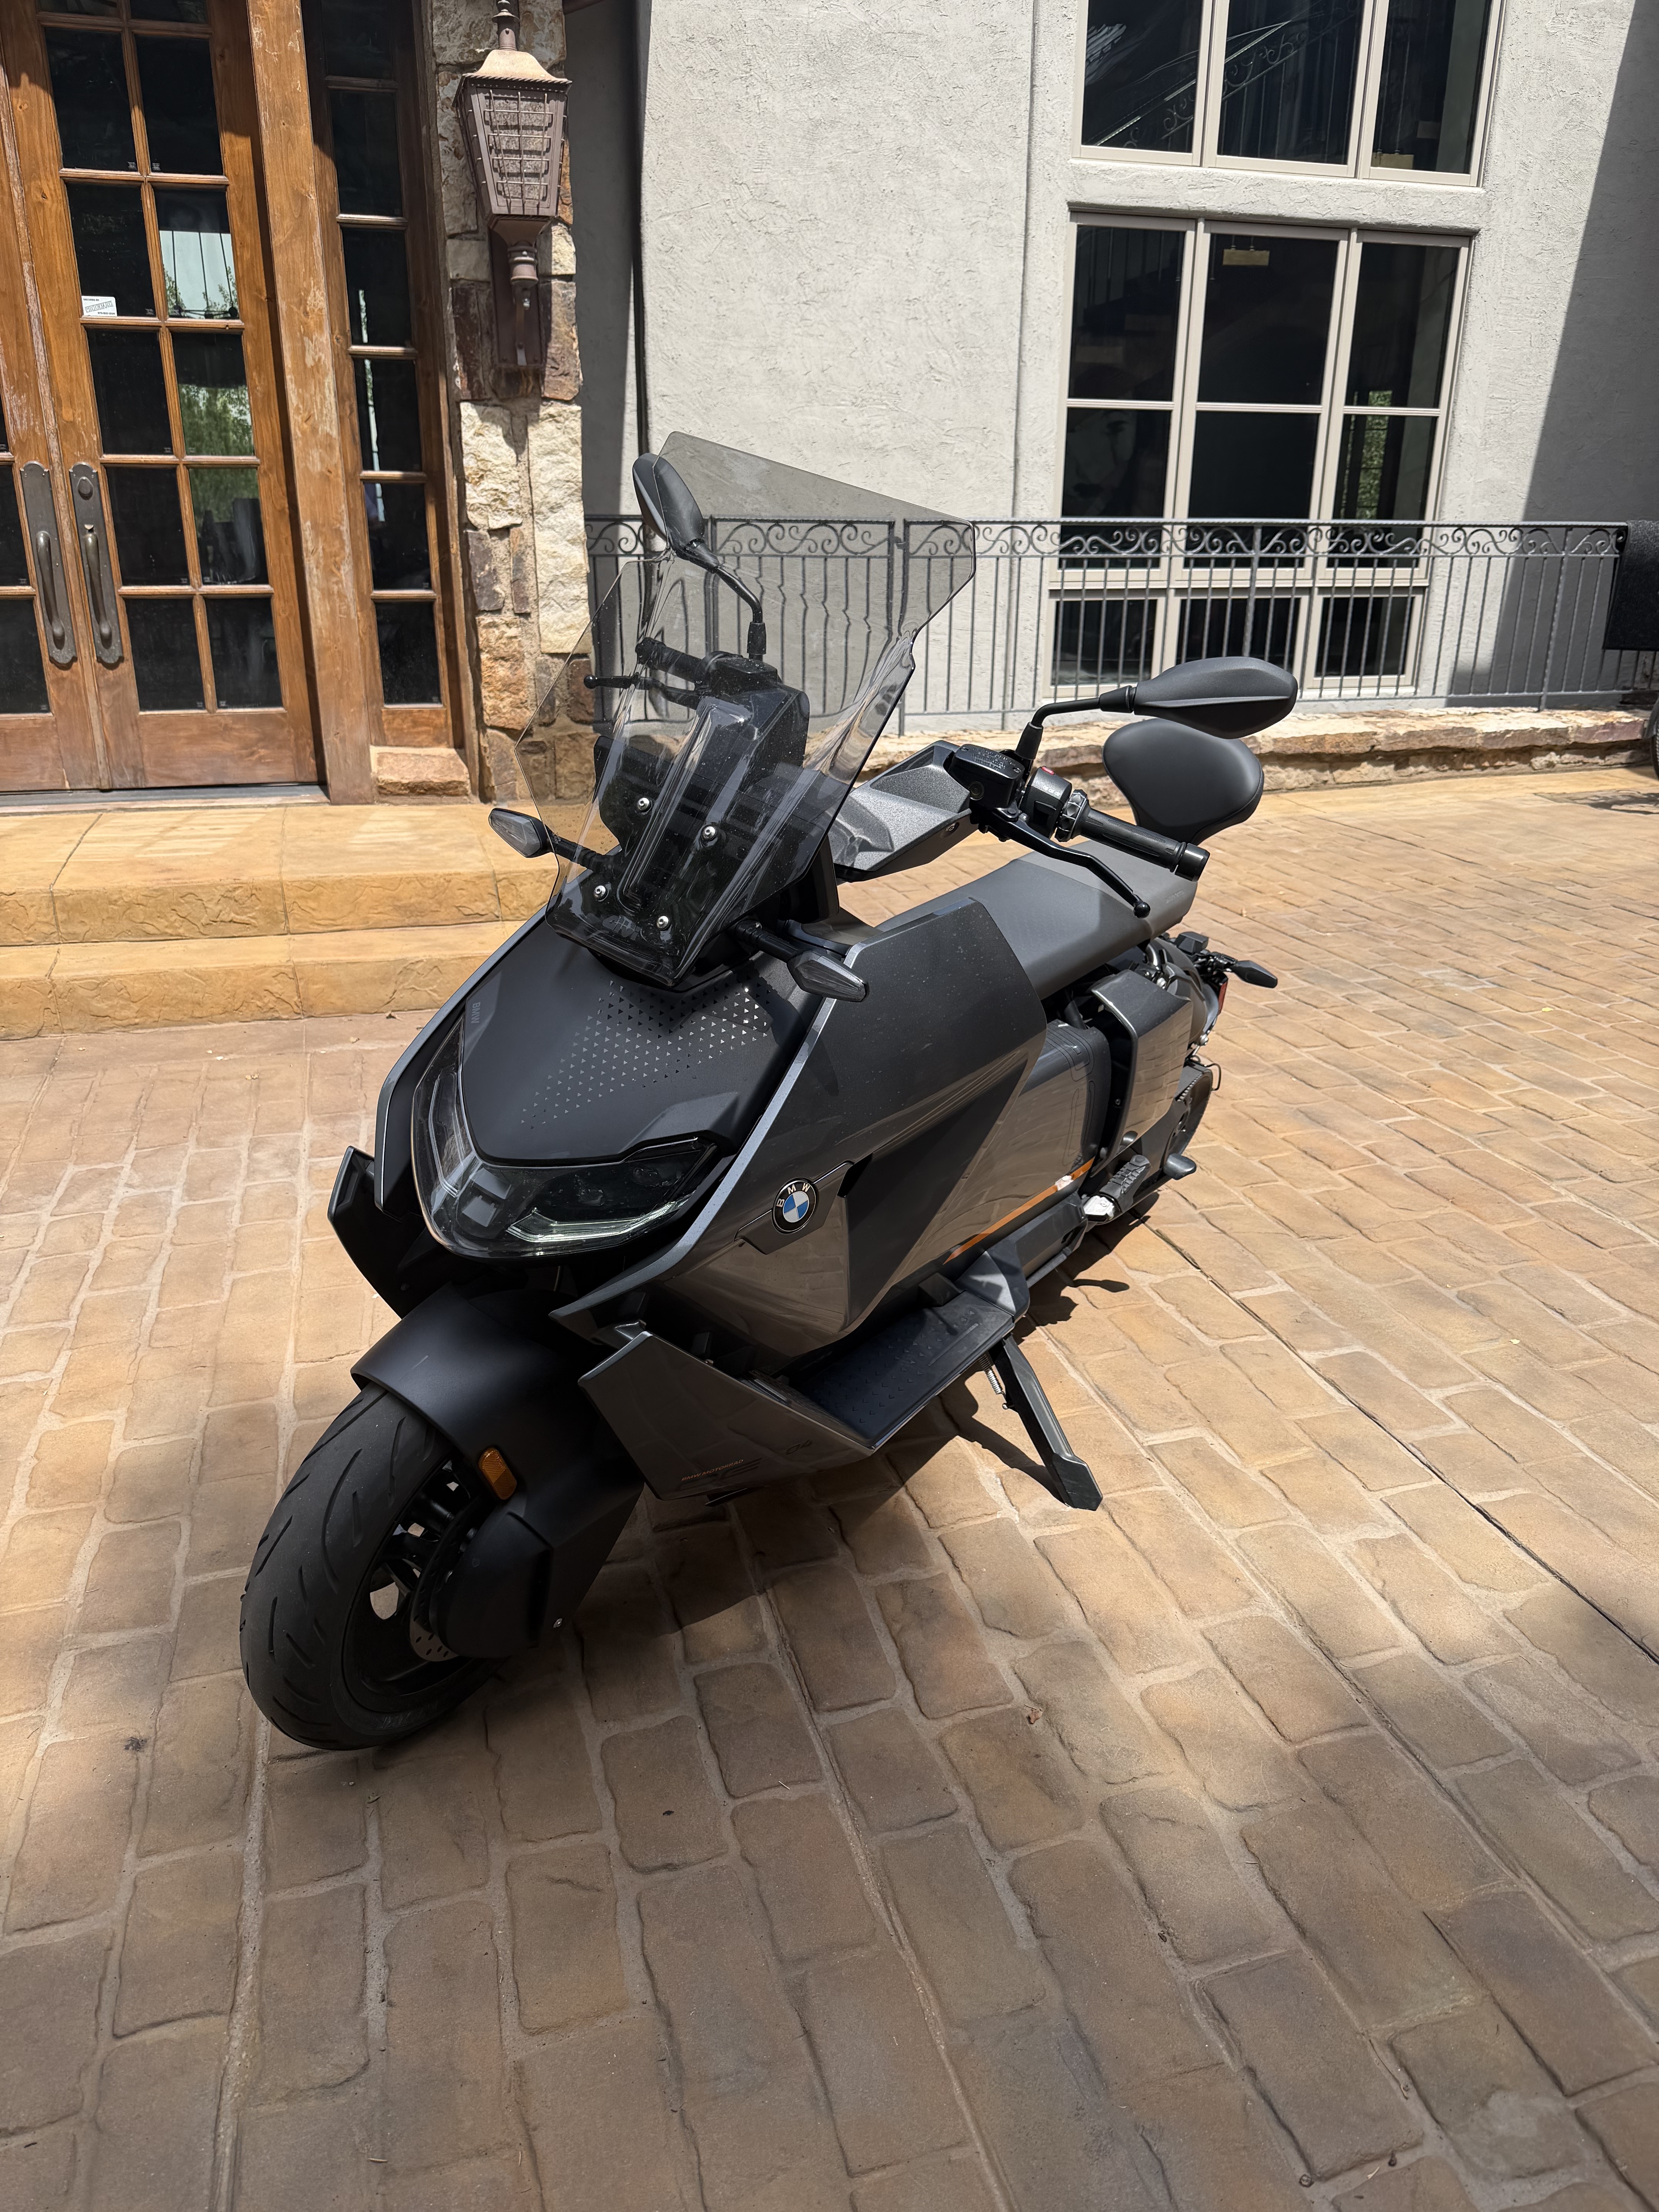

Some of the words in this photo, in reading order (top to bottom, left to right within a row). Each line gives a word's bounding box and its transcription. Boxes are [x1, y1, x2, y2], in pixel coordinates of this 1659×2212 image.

[602, 915, 641, 941] GIVI
[471, 1001, 481, 1024] BMW
[776, 1183, 811, 1207] BMW
[681, 1472, 701, 1481] BMW
[702, 1459, 744, 1475] MOTORRAD
